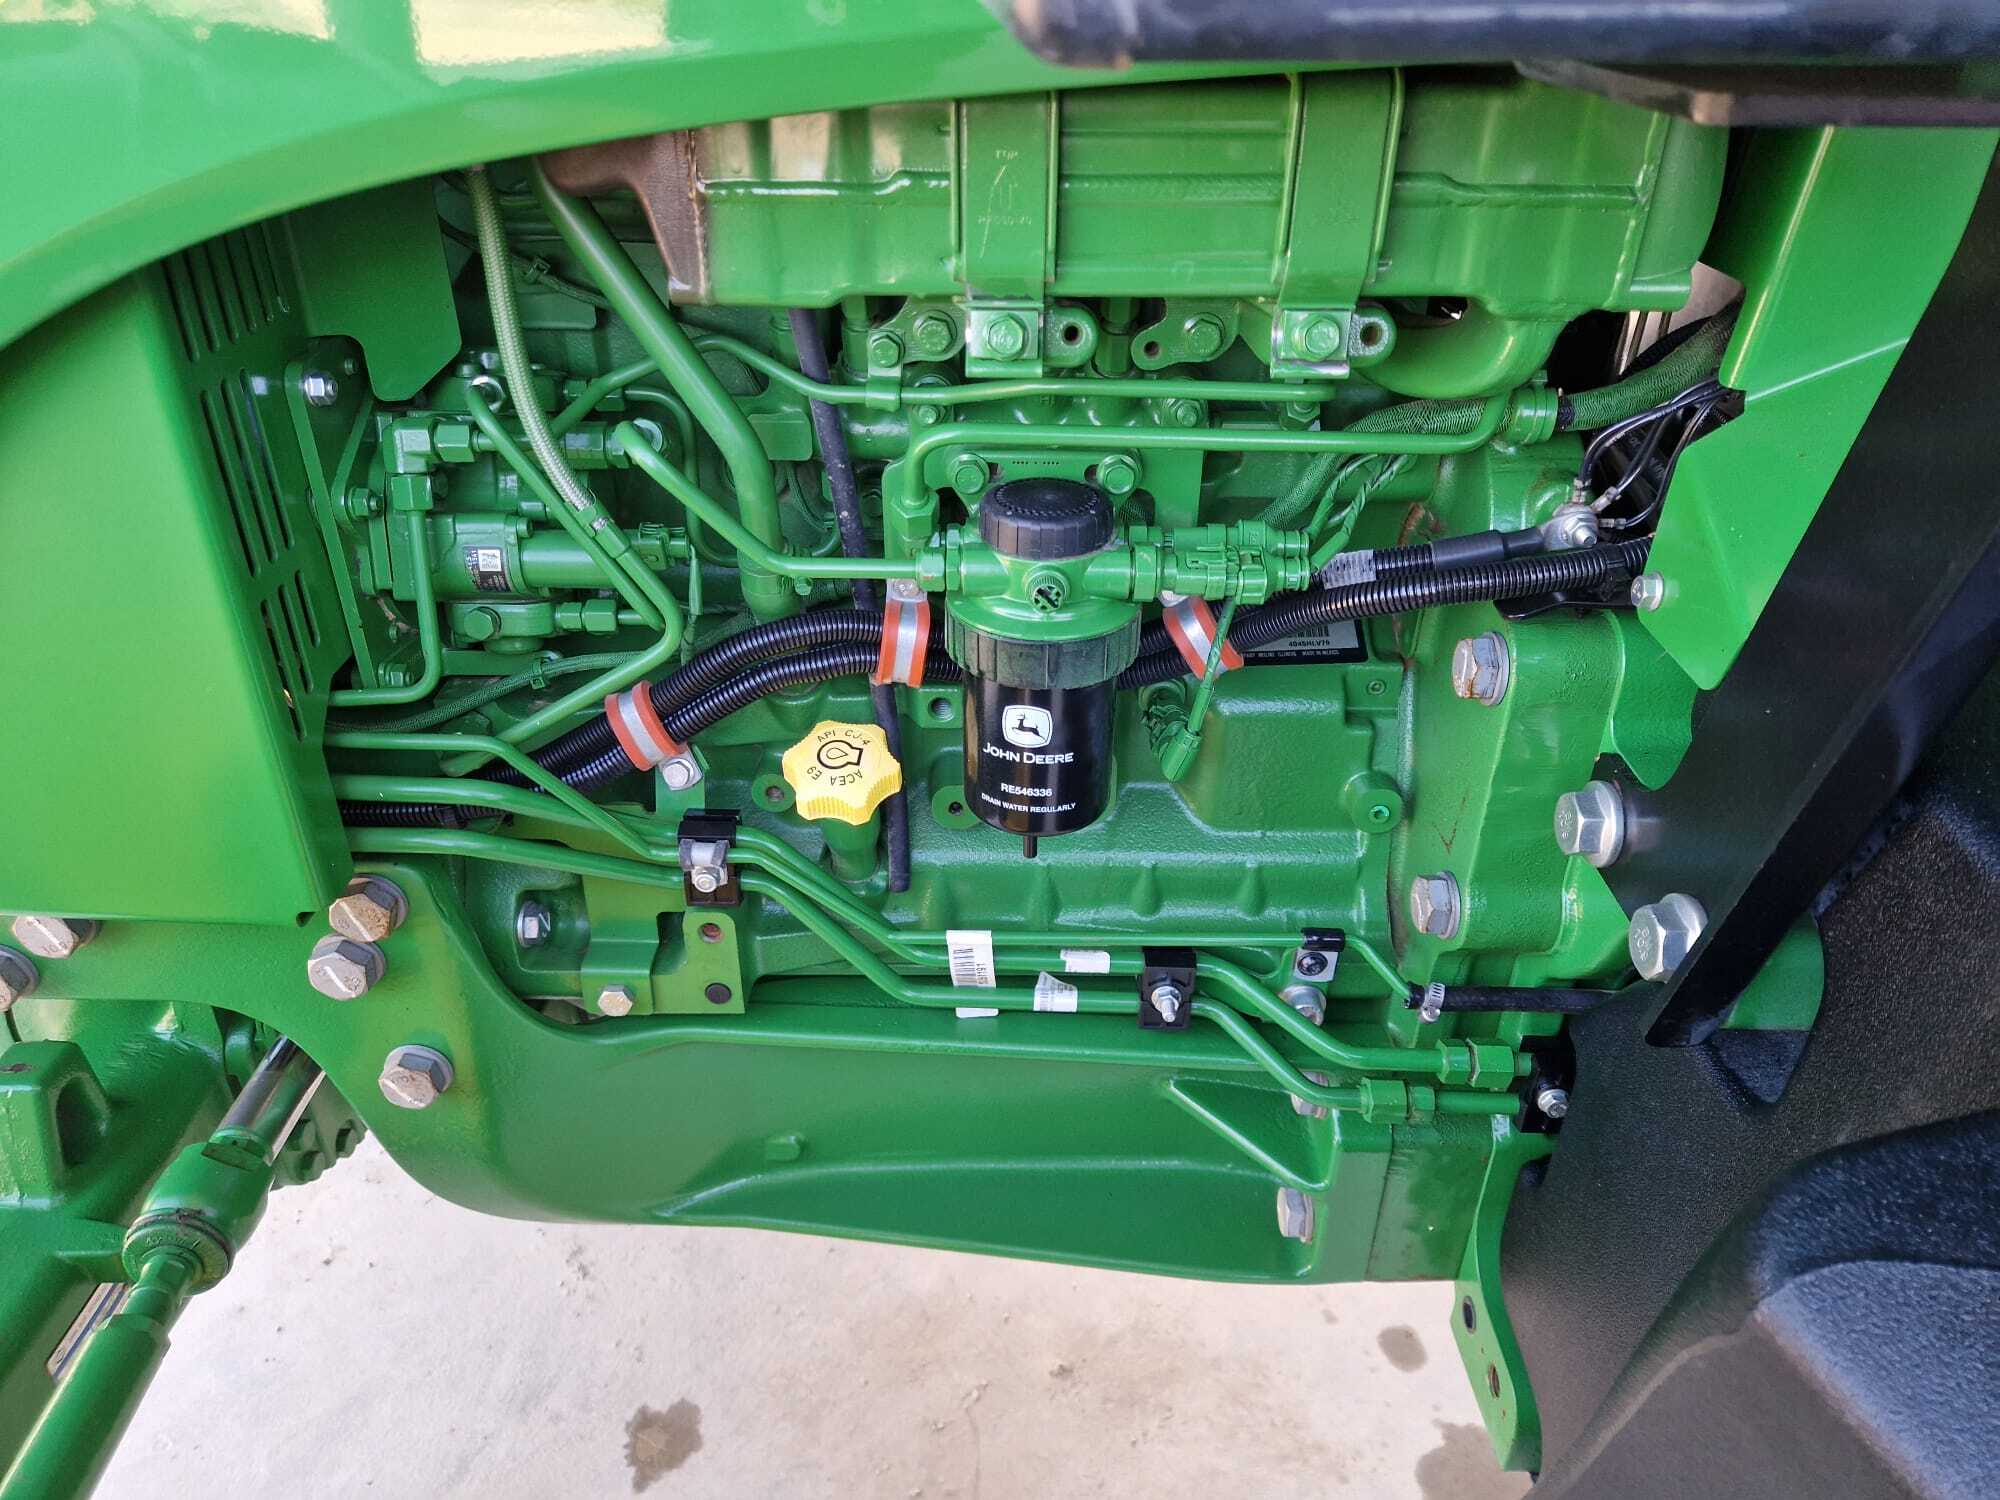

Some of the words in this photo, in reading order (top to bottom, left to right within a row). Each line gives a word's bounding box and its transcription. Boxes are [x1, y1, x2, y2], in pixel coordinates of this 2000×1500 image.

[817, 730, 836, 742] API
[845, 729, 871, 746] CJ-4
[983, 742, 1020, 762] JOHN
[1023, 752, 1074, 765] DEERE
[830, 769, 863, 786] ACEA
[1000, 783, 1053, 797] RE546336
[981, 793, 1001, 807] DRAIN
[1002, 801, 1028, 813] WATER
[1030, 802, 1076, 813] REGULARLY
